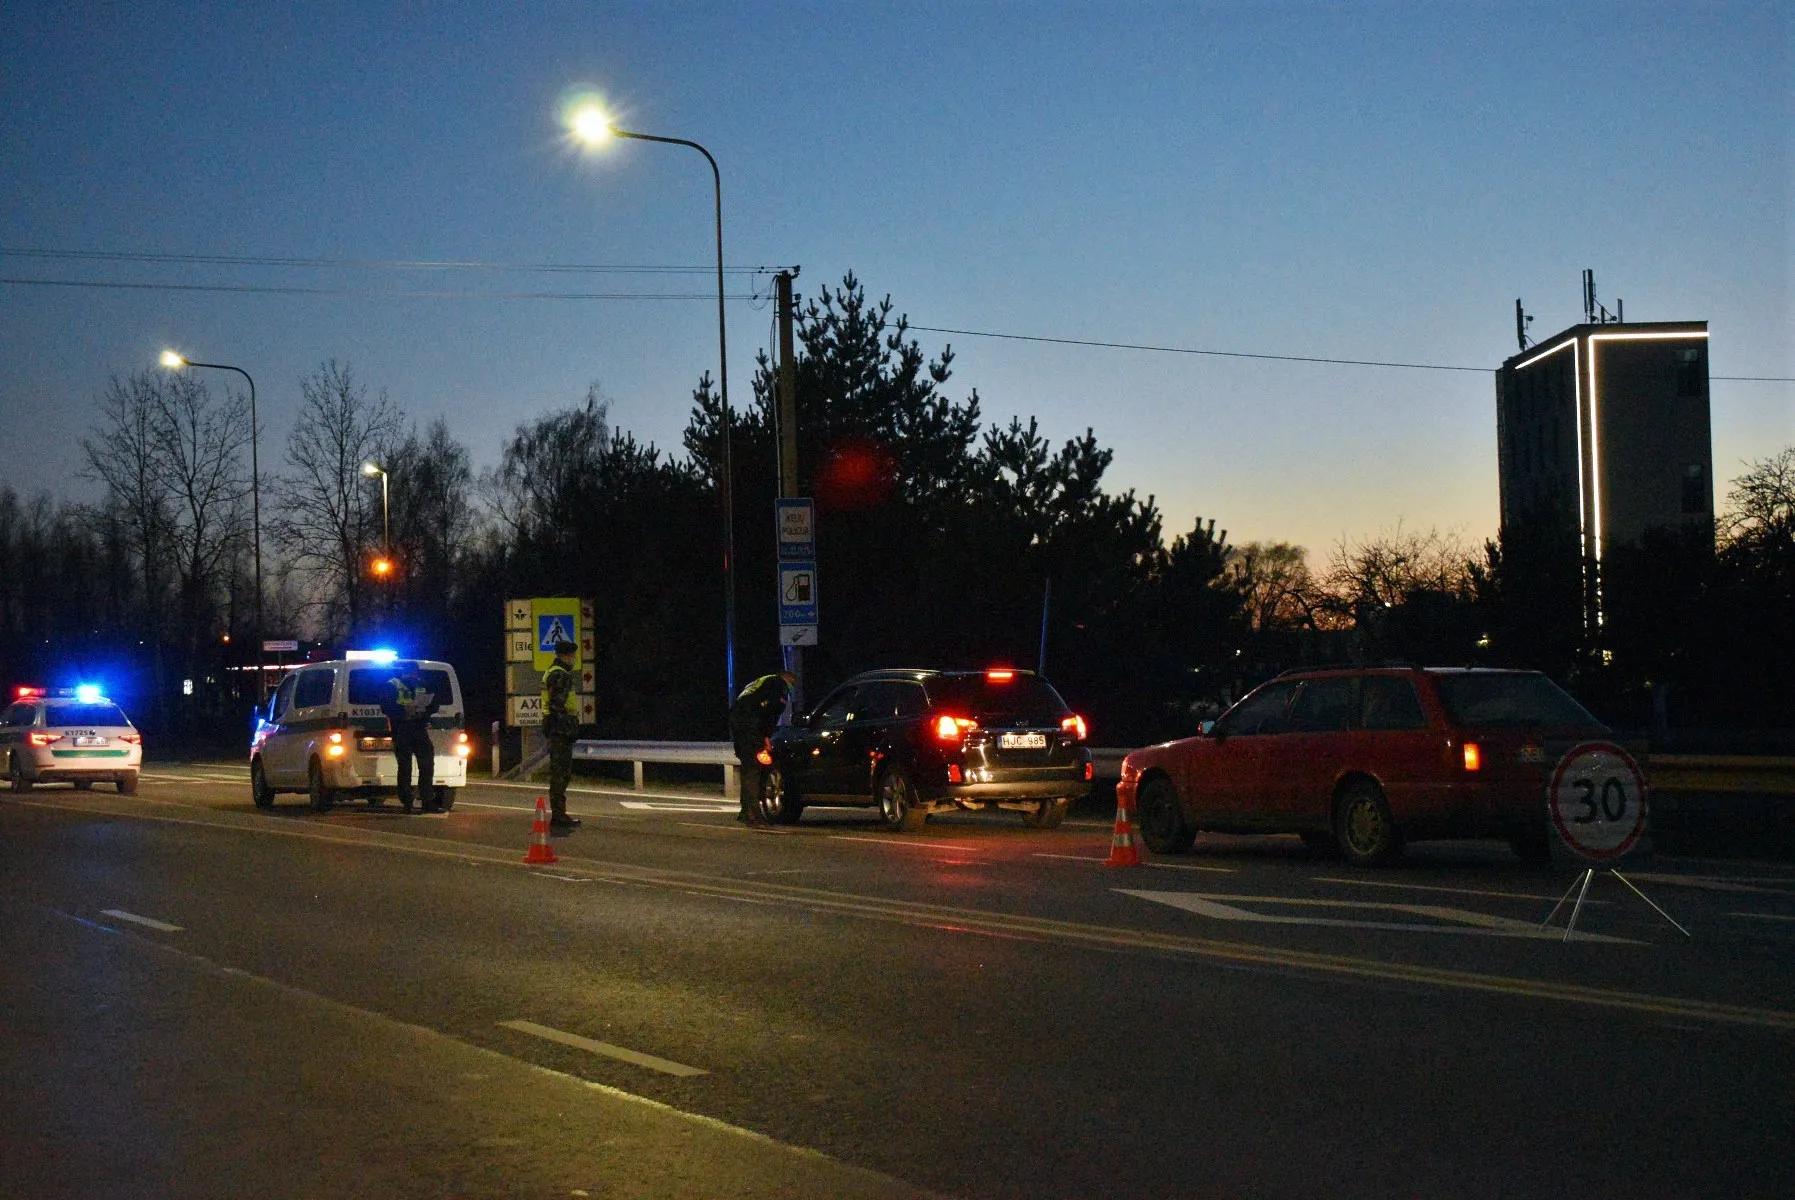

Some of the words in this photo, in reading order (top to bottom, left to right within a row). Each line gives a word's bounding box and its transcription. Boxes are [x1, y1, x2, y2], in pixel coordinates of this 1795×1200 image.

[352, 708, 381, 717] K1037
[1003, 736, 1023, 746] HJC
[1027, 736, 1045, 745] 985
[1572, 776, 1627, 823] 30
